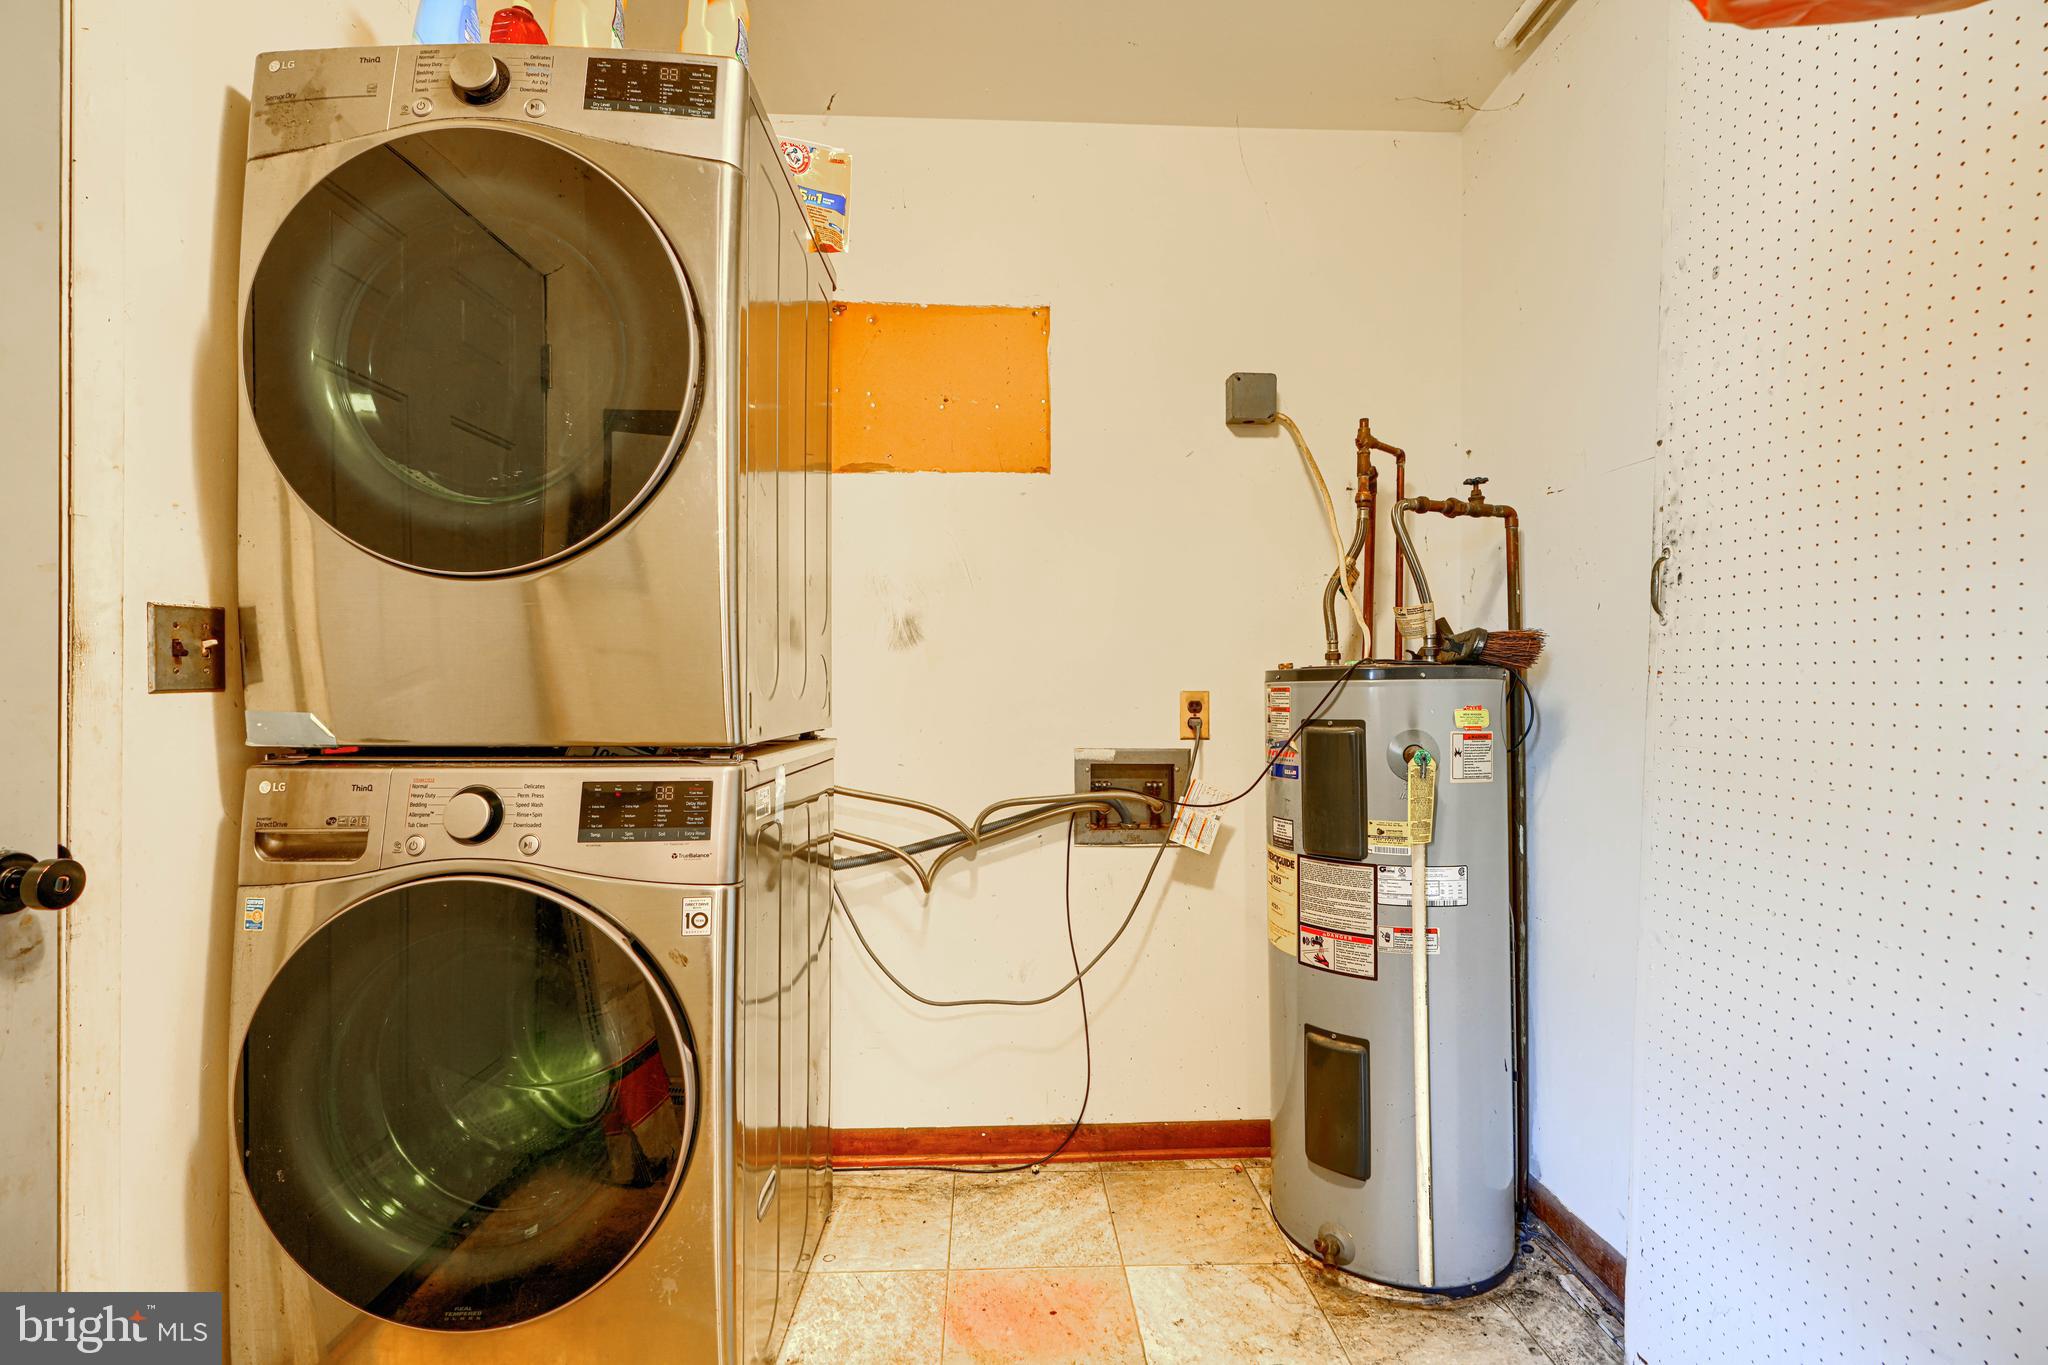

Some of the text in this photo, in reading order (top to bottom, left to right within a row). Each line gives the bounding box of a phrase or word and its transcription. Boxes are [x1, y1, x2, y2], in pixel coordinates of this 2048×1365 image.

[360, 56, 381, 64] ThinQ
[282, 61, 295, 69] LG
[800, 188, 808, 201] 5
[817, 194, 822, 204] 1
[272, 783, 286, 792] LG
[352, 784, 373, 792] ThinQ
[685, 912, 709, 929] 10
[1326, 932, 1352, 941] DANGER
